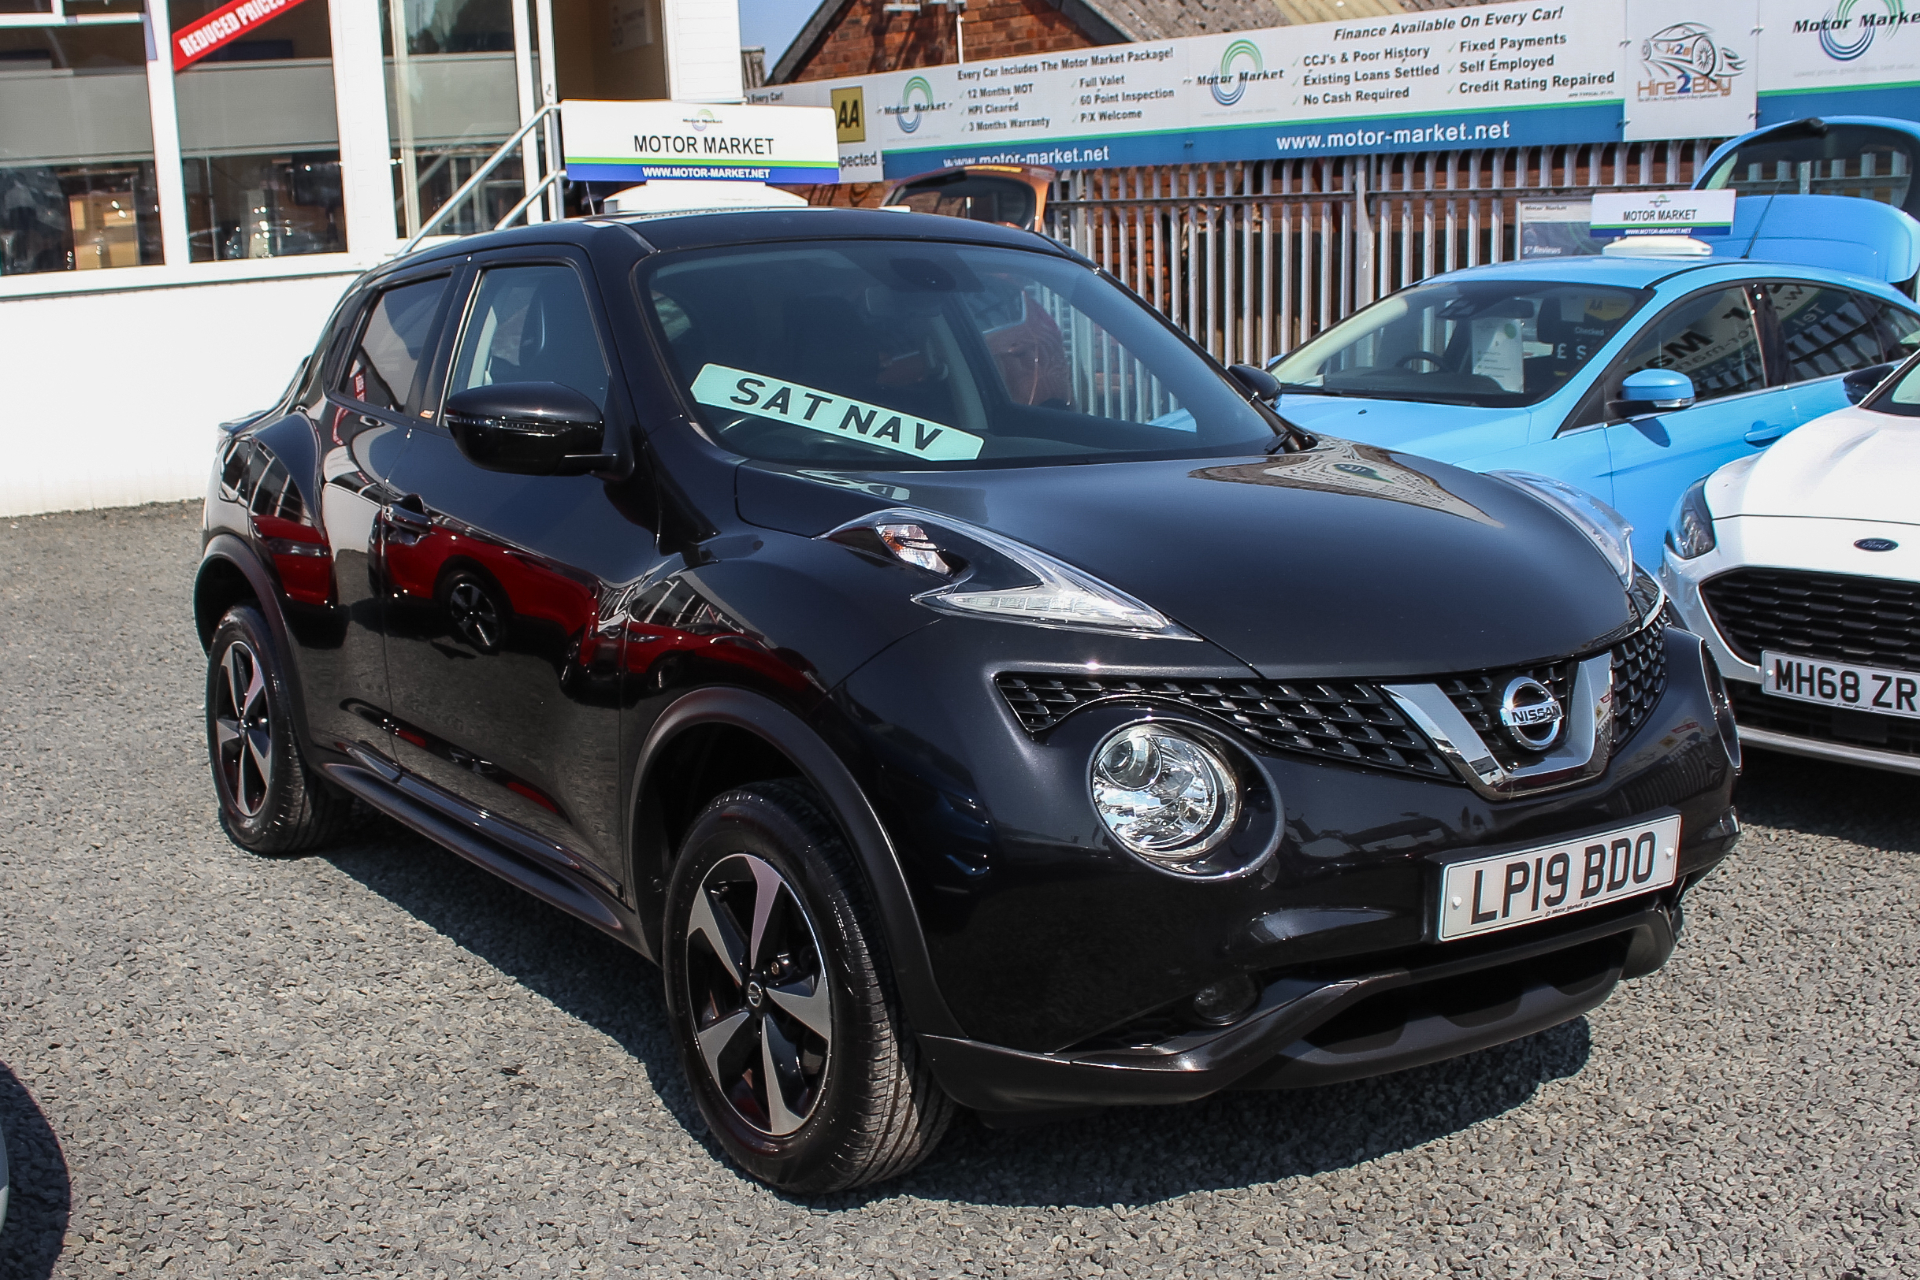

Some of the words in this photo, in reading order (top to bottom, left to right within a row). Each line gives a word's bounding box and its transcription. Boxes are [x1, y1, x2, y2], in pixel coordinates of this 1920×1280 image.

[1334, 24, 1387, 41] Finance
[1390, 17, 1456, 36] Available
[1461, 15, 1480, 28] On
[1485, 11, 1527, 27] Every
[1532, 6, 1564, 21] Car!
[1793, 18, 1851, 34] Motor
[179, 11, 240, 57] REDUCED
[1460, 39, 1495, 53] Fixed
[1500, 33, 1567, 51] Payments
[957, 69, 981, 81] Every
[983, 67, 998, 78] Car
[1000, 64, 1038, 76] Includes
[1041, 61, 1059, 73] The
[1061, 58, 1088, 69] Motor
[1091, 54, 1125, 66] Market
[1127, 47, 1174, 63] Package!
[1304, 53, 1336, 67] CCJ's
[1340, 52, 1349, 63] &
[1353, 50, 1380, 62] Poor
[1384, 46, 1430, 60] History
[1460, 60, 1484, 73] Self
[1490, 54, 1555, 72] Employed
[1079, 77, 1097, 88] Full
[1099, 75, 1125, 87] Valet
[1196, 74, 1234, 86] Motor
[1239, 69, 1285, 82] Market
[1304, 71, 1350, 87] Existing
[1354, 67, 1390, 81] Loans
[1395, 64, 1439, 79] Settled
[1460, 80, 1499, 94] Credit
[1504, 77, 1548, 92] Rating
[1552, 71, 1615, 88] Repaired
[967, 89, 977, 99] 12
[980, 86, 1011, 98] Months
[1013, 83, 1034, 95] MOT
[1080, 96, 1092, 106] 60
[1094, 92, 1119, 104] Point
[1121, 88, 1174, 103] Inspection
[1303, 94, 1319, 105] No
[1323, 91, 1352, 103] Cash
[1355, 86, 1410, 104] Required
[837, 100, 859, 128] AA
[885, 106, 909, 116] Motor
[914, 102, 946, 113] Market
[968, 105, 982, 116] HPI
[985, 101, 1019, 114] Cleared
[1098, 109, 1142, 121] Welcome
[969, 122, 975, 132] 3
[977, 119, 1007, 131] Months
[1009, 116, 1050, 129] Warranty
[1276, 120, 1510, 150] www.motor-market.net
[634, 135, 698, 153] MOTOR
[704, 137, 774, 155] MARKET
[839, 151, 877, 168] pected
[943, 145, 1109, 167] wwwmotor-market.net
[642, 167, 770, 179] WWW.MOTOR-MARKET.NET
[1623, 210, 1656, 221] MOTOR
[1658, 209, 1697, 220] MARKET
[729, 378, 832, 421] SAT
[839, 404, 943, 451] NAV
[1775, 659, 1860, 704] MH68
[1871, 674, 1918, 712] ZR
[1512, 705, 1559, 722] NISSAN
[1470, 852, 1570, 925] LP19
[1580, 831, 1656, 900] BDO
